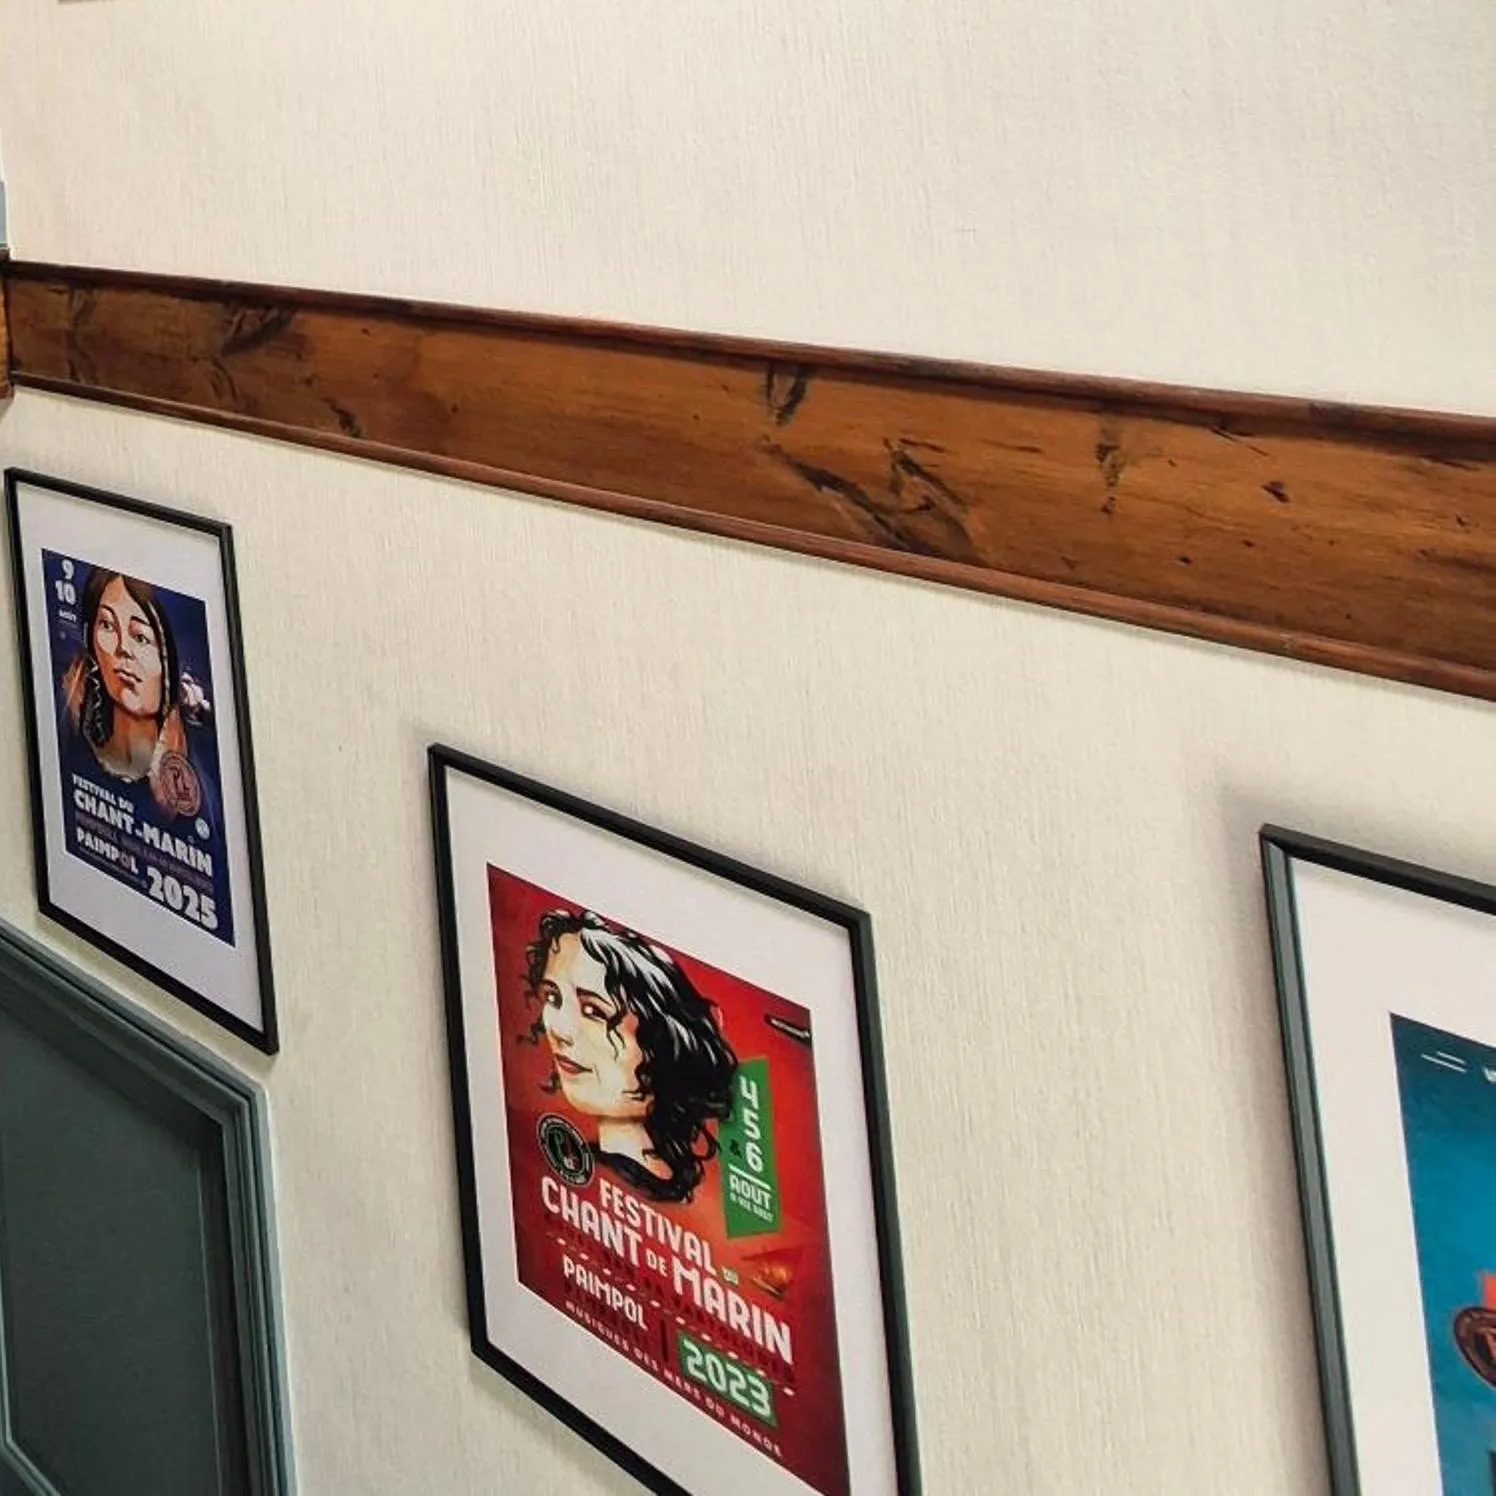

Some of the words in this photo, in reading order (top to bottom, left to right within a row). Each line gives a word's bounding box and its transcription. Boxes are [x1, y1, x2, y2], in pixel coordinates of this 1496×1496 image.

[55, 580, 76, 605] 10
[62, 559, 74, 580] 9
[73, 789, 134, 835] CHANT
[143, 822, 212, 876] MARIN
[77, 826, 139, 875] PAIMPOL
[147, 866, 218, 930] 2025
[739, 1075, 759, 1110] 4
[743, 1107, 761, 1140] 5
[745, 1141, 764, 1173] 6
[599, 1178, 718, 1276] FESTIVAL
[541, 1175, 643, 1267] CHANT
[645, 1248, 668, 1278] DE
[671, 1254, 793, 1365] MARIN
[562, 1254, 648, 1331] PAIMPOL
[565, 1300, 630, 1352] MUSIQUES
[682, 1337, 771, 1419] 2023
